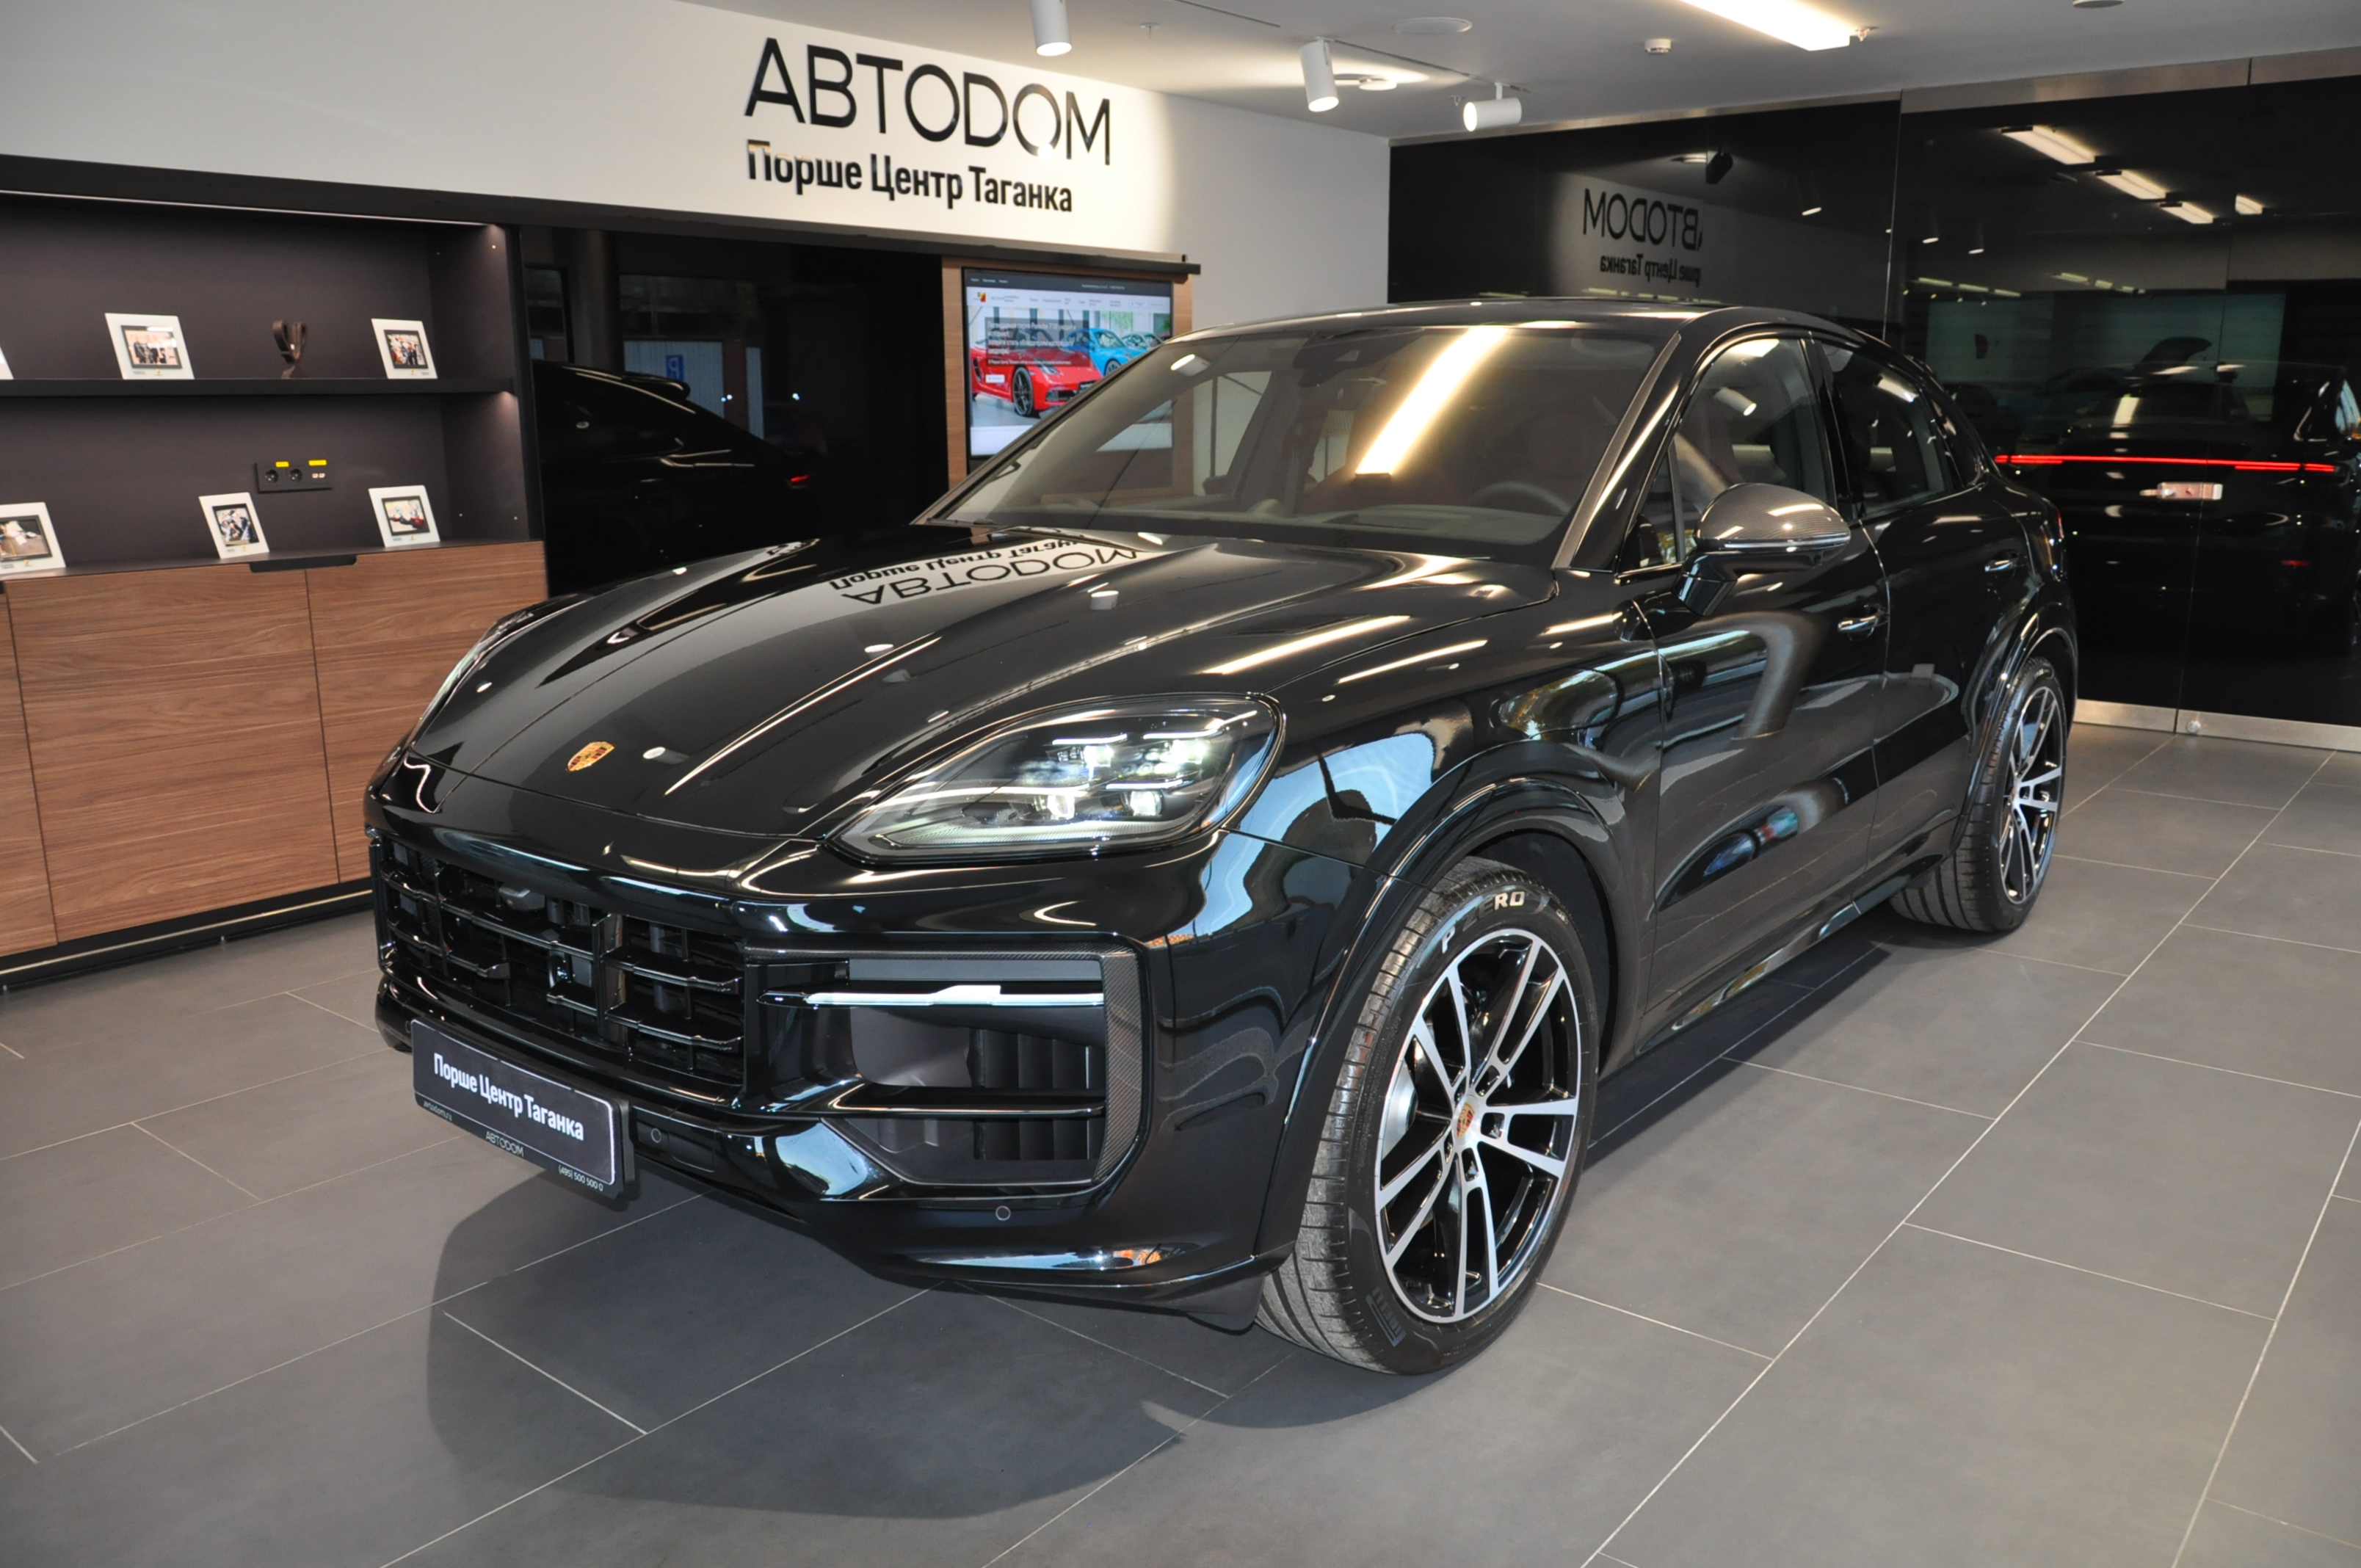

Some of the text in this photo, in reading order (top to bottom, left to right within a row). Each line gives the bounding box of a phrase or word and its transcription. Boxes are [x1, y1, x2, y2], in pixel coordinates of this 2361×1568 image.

[747, 139, 1073, 212] Порше Центр Таганка
[1442, 926, 1456, 954] P
[1462, 890, 1526, 932] ZERO
[434, 1052, 584, 1141] Порше Центр Таганка
[573, 1172, 586, 1184] 500
[586, 1177, 598, 1189] 500
